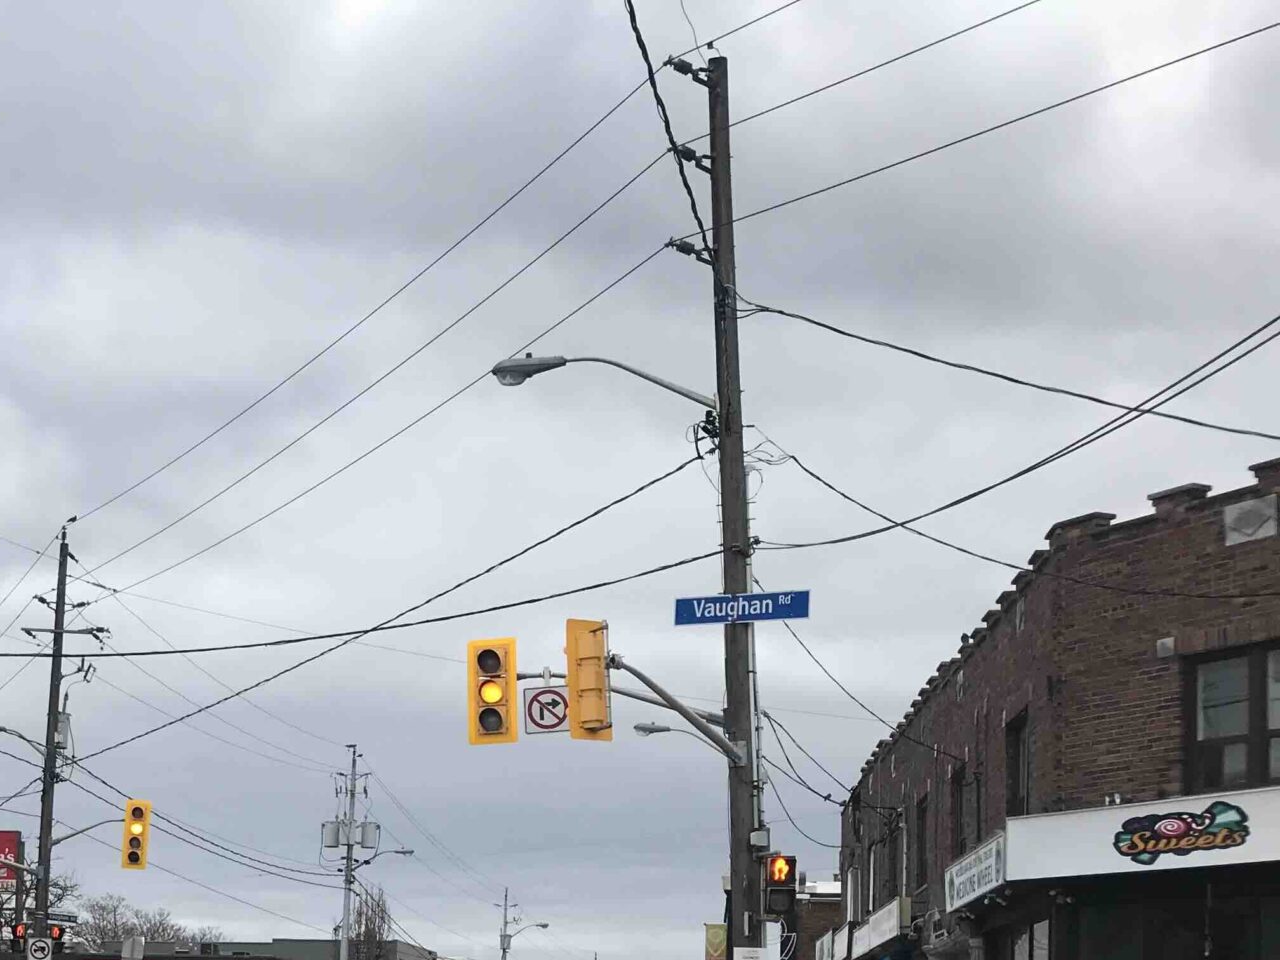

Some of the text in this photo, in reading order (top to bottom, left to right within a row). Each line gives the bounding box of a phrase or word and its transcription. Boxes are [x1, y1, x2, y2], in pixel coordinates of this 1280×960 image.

[694, 594, 791, 620] Vaughan Rd
[1121, 828, 1246, 853] Sweets
